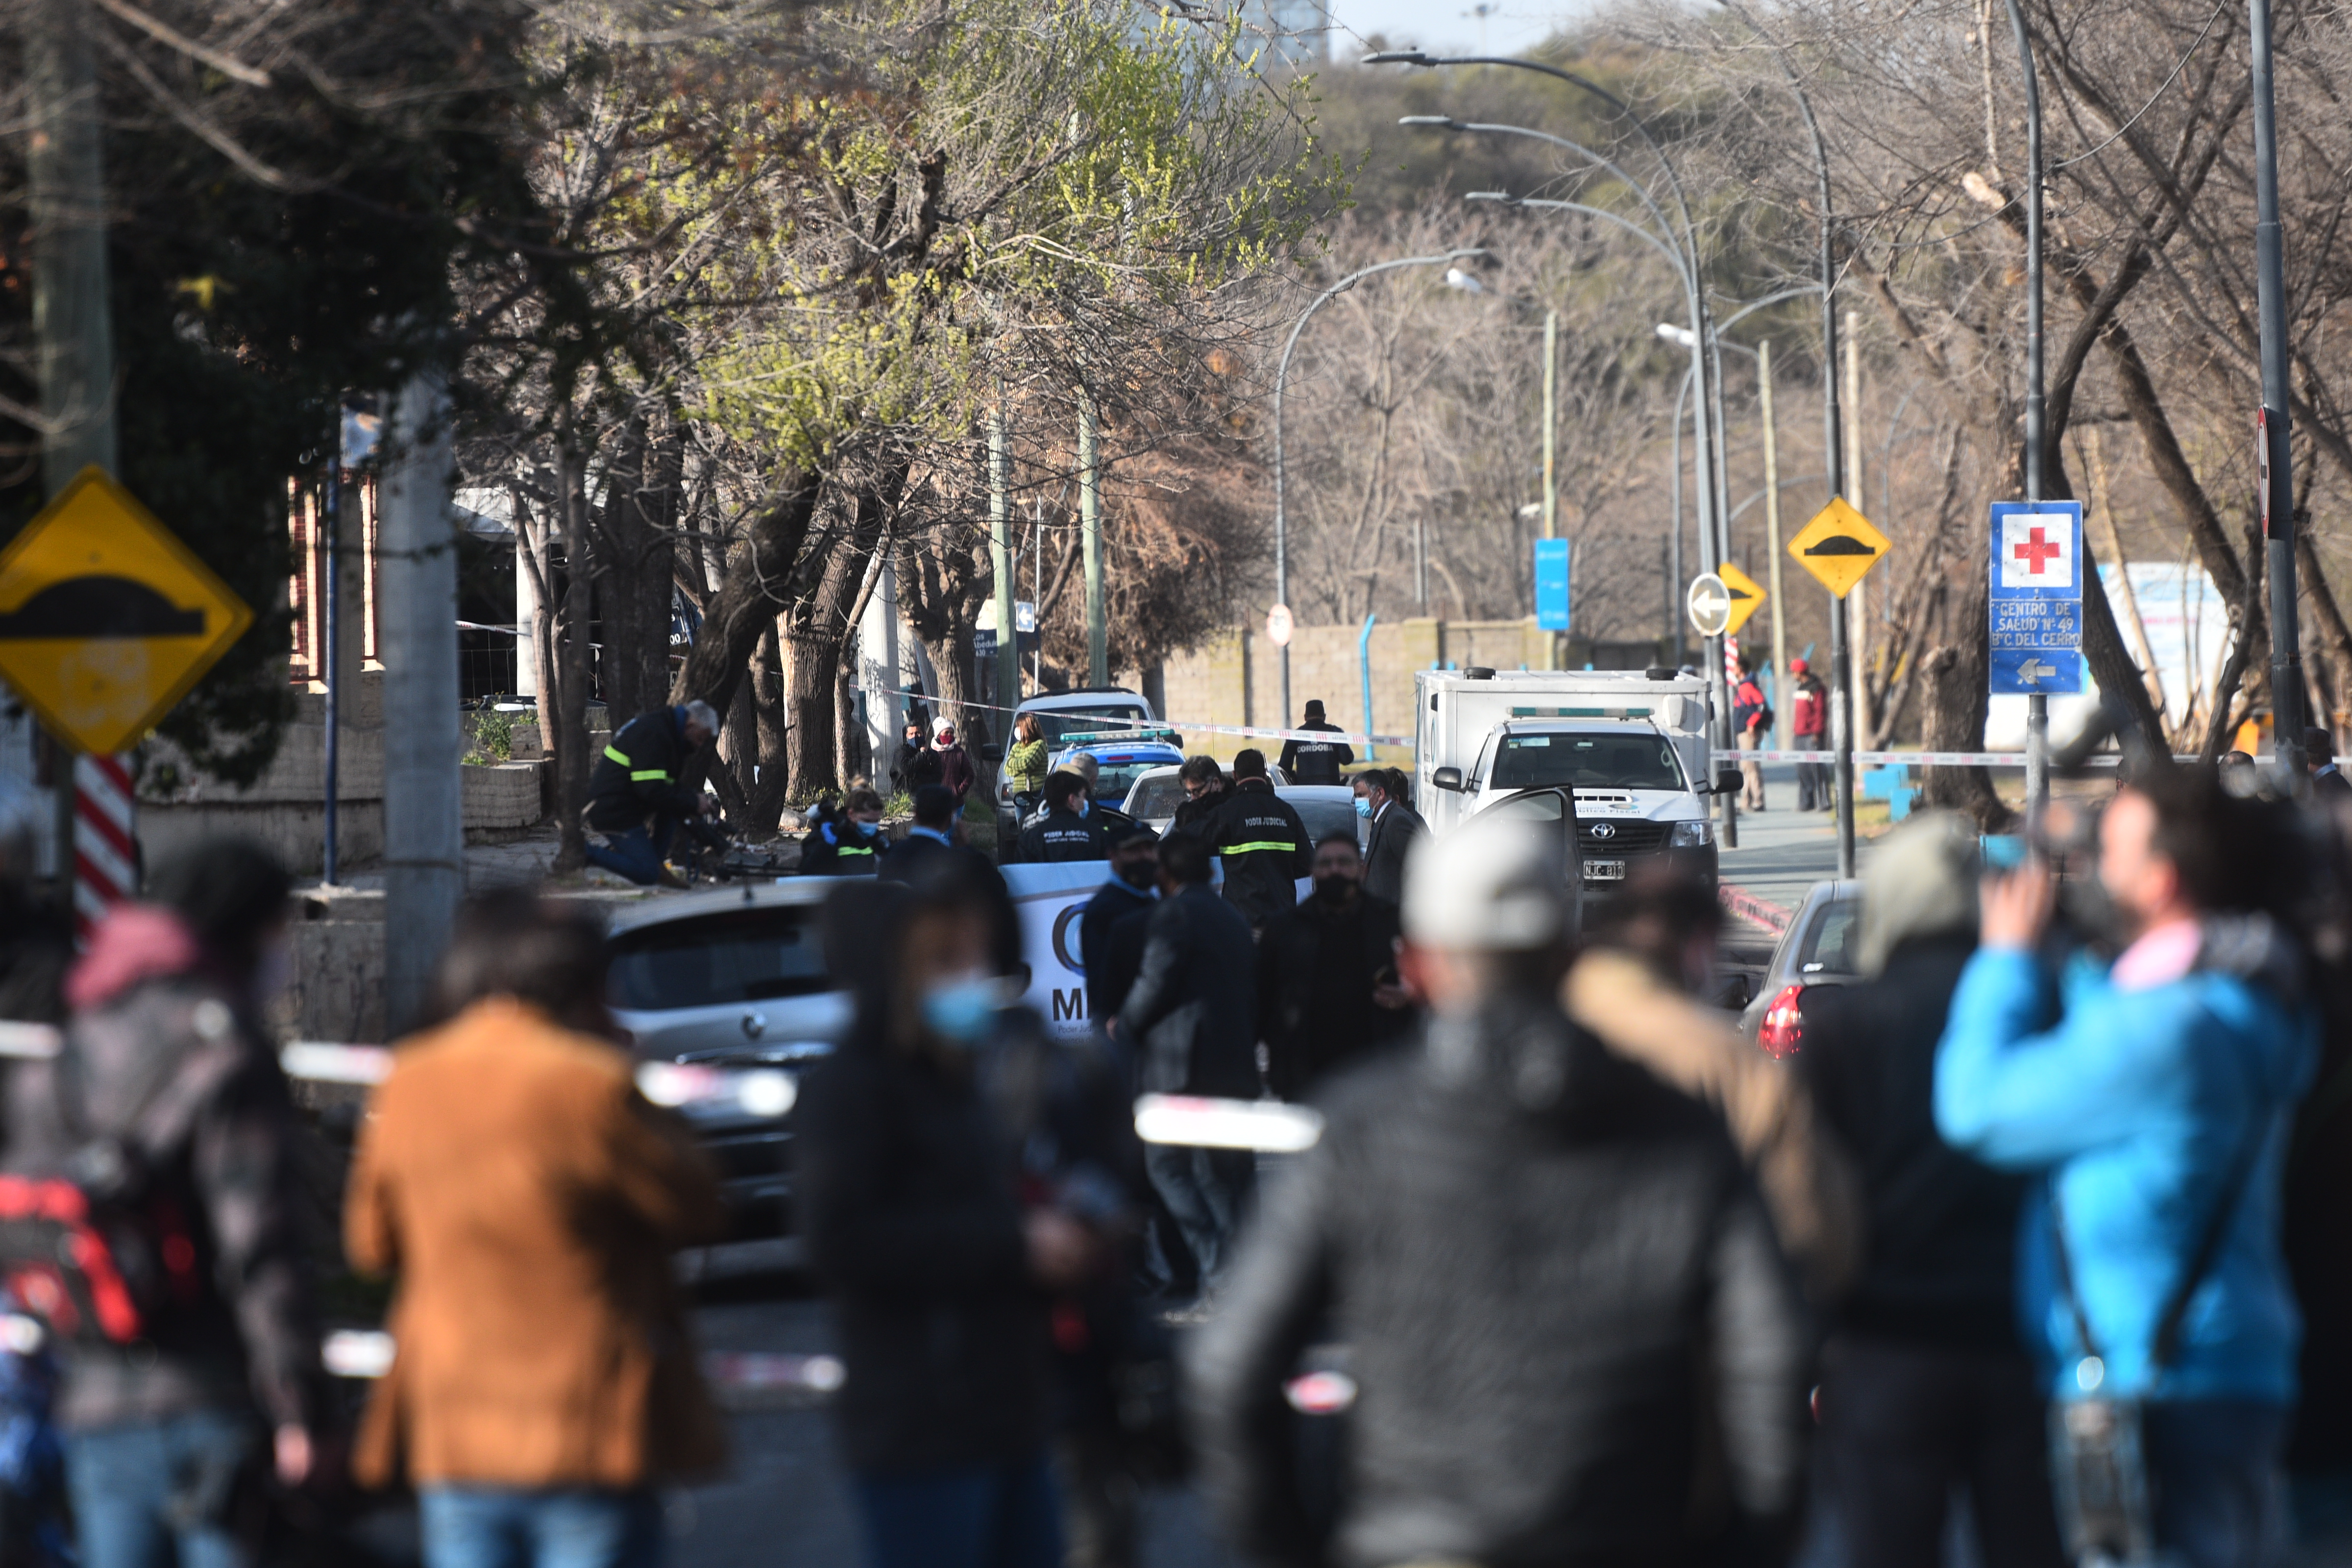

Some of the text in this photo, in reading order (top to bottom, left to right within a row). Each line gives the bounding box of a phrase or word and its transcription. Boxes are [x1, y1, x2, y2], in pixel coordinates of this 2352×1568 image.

[2000, 602, 2071, 616] CENTRO DE
[1999, 617, 2038, 631] SALUD
[2058, 617, 2074, 632] 49
[2016, 633, 2038, 646] DEL
[2042, 633, 2081, 646] CERRO
[1586, 865, 1623, 876] NJC 810
